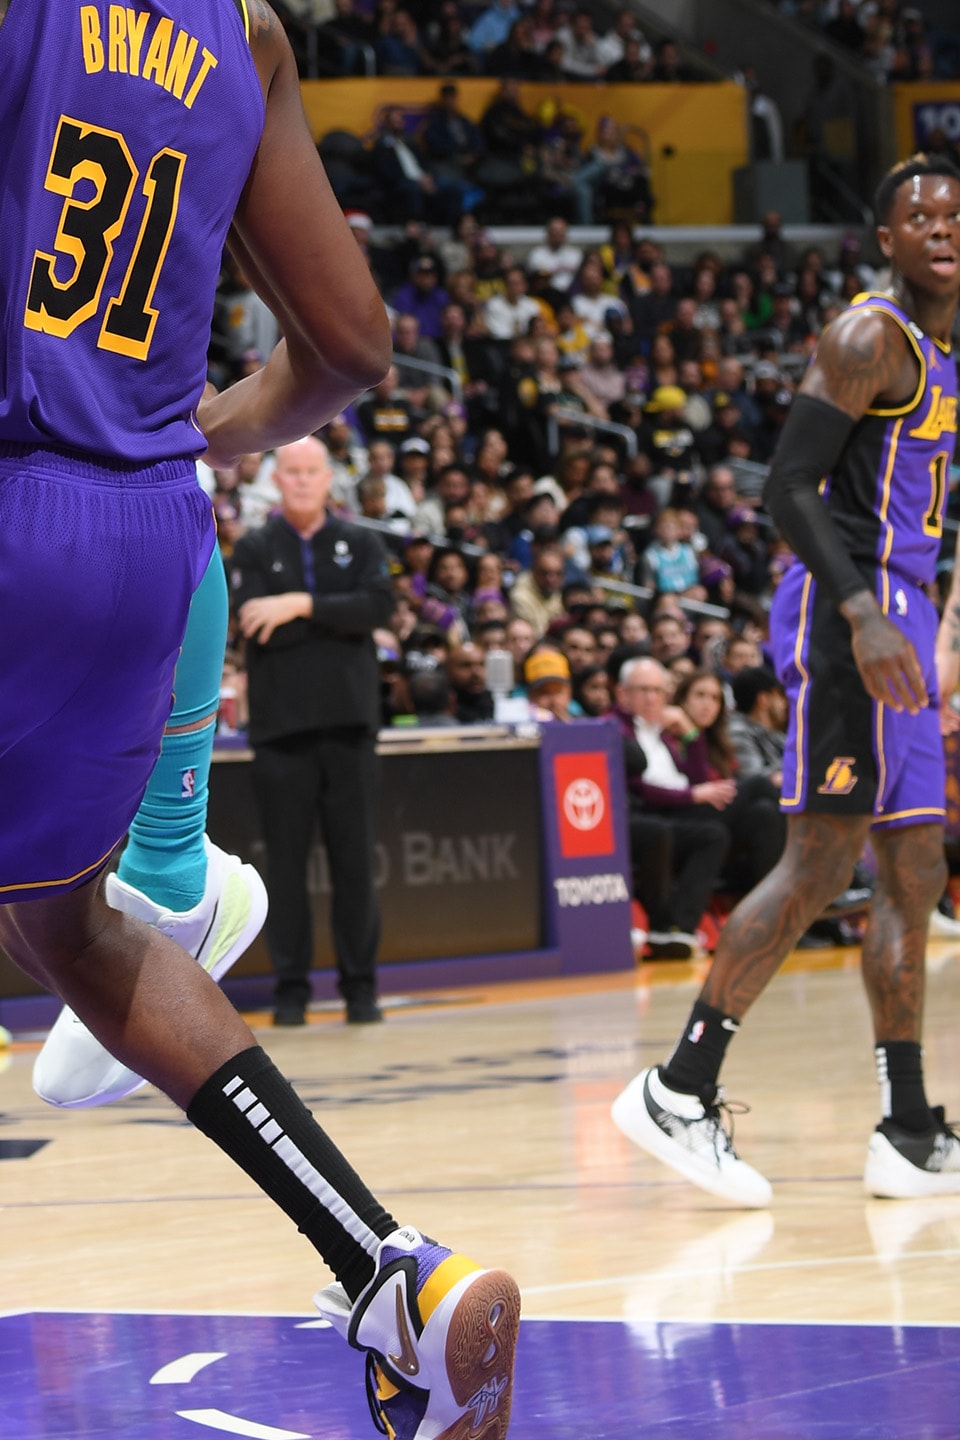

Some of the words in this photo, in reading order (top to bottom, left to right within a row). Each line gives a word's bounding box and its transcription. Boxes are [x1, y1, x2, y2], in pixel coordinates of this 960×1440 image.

[80, 4, 219, 110] BRYANT
[24, 114, 187, 361] 31
[402, 832, 519, 887] BANK
[553, 873, 630, 907] TOYOTA
